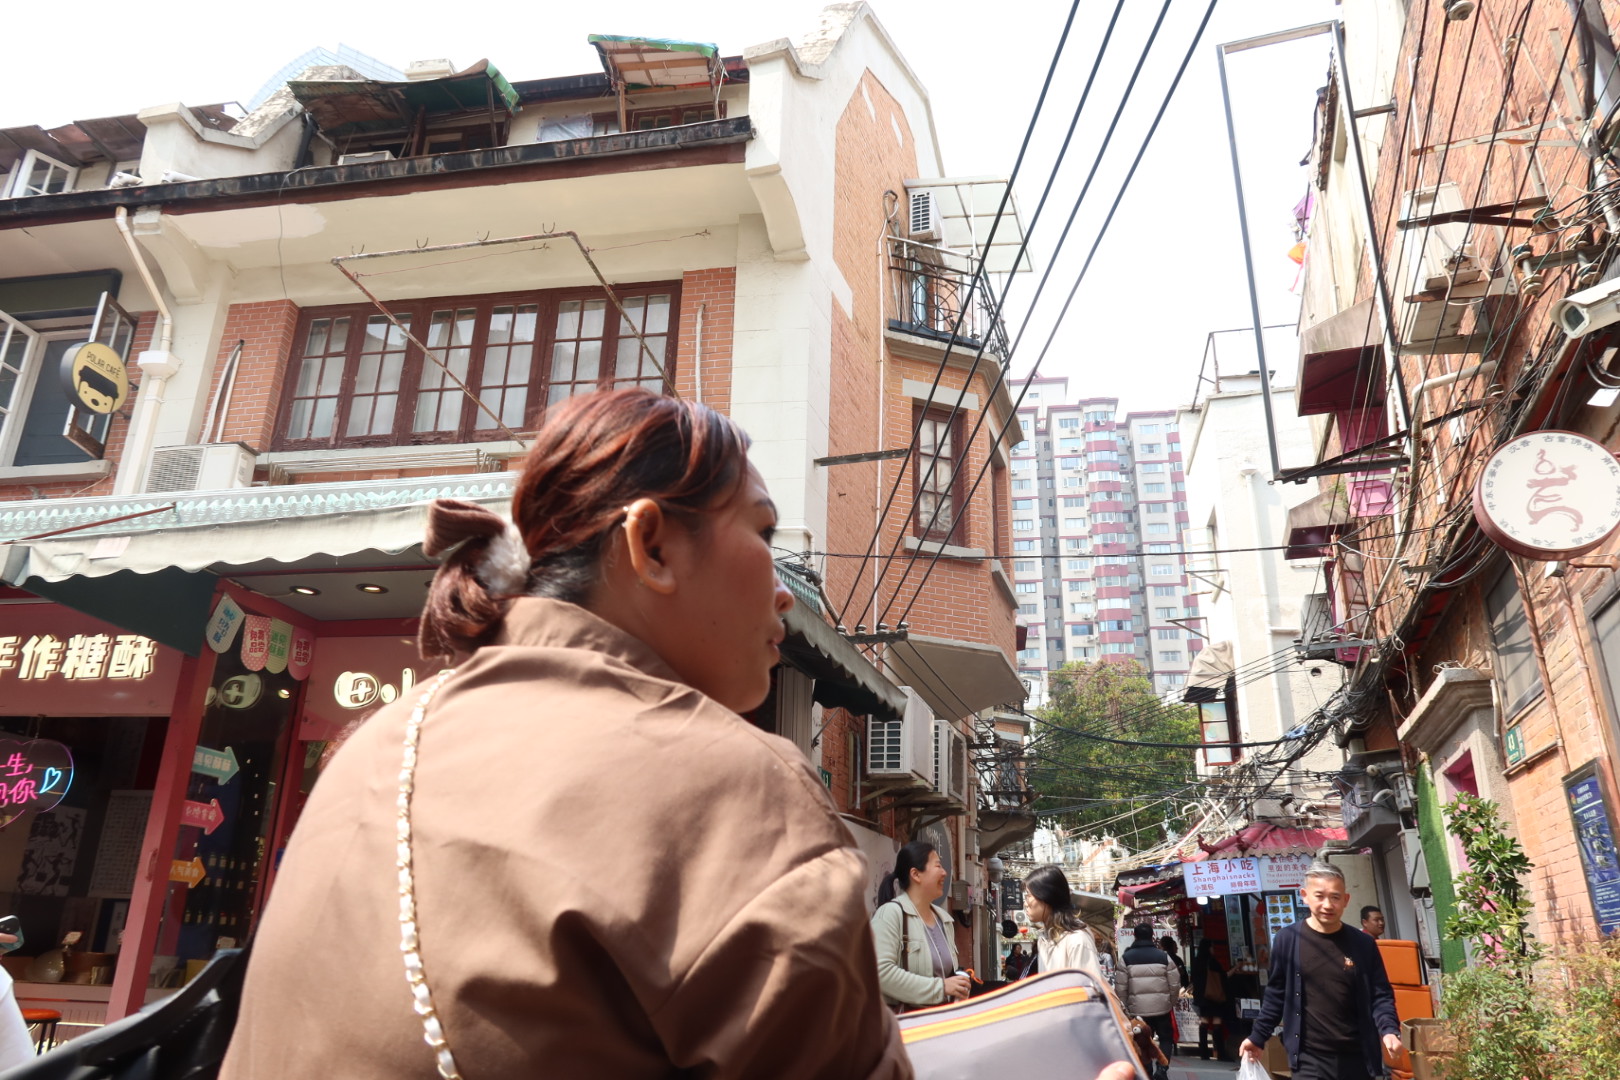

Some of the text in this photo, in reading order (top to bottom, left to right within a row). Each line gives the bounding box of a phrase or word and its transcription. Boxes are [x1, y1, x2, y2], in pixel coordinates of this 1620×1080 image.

[87, 351, 122, 378] POLAR CAFÉ
[1192, 859, 1254, 876] 上海小吃
[1193, 872, 1255, 884] Shanghaisnacks
